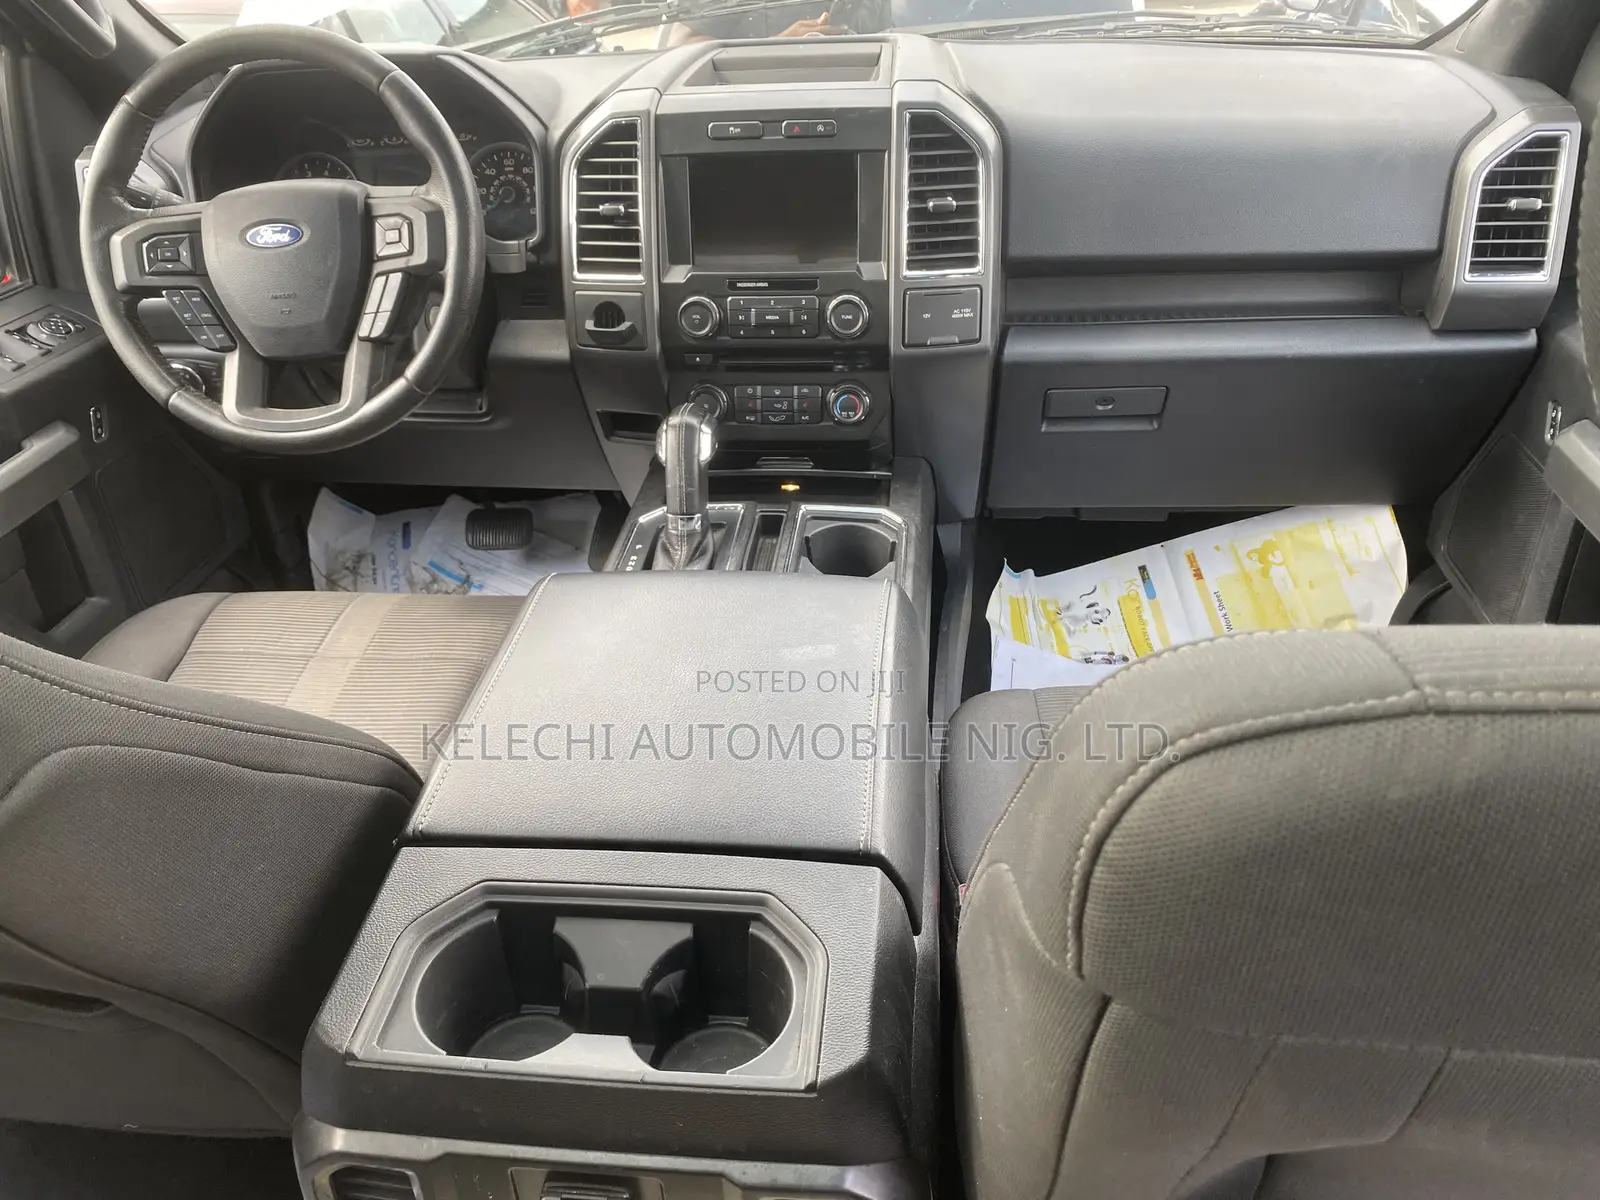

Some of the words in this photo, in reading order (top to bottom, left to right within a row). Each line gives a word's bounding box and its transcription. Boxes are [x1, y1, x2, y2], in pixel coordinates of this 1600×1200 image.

[484, 167, 496, 175] 40
[503, 158, 515, 166] 60
[257, 226, 290, 244] Ford
[1213, 590, 1226, 612] Sheet
[1135, 605, 1145, 627] ROBOT
[1221, 612, 1234, 633] Work
